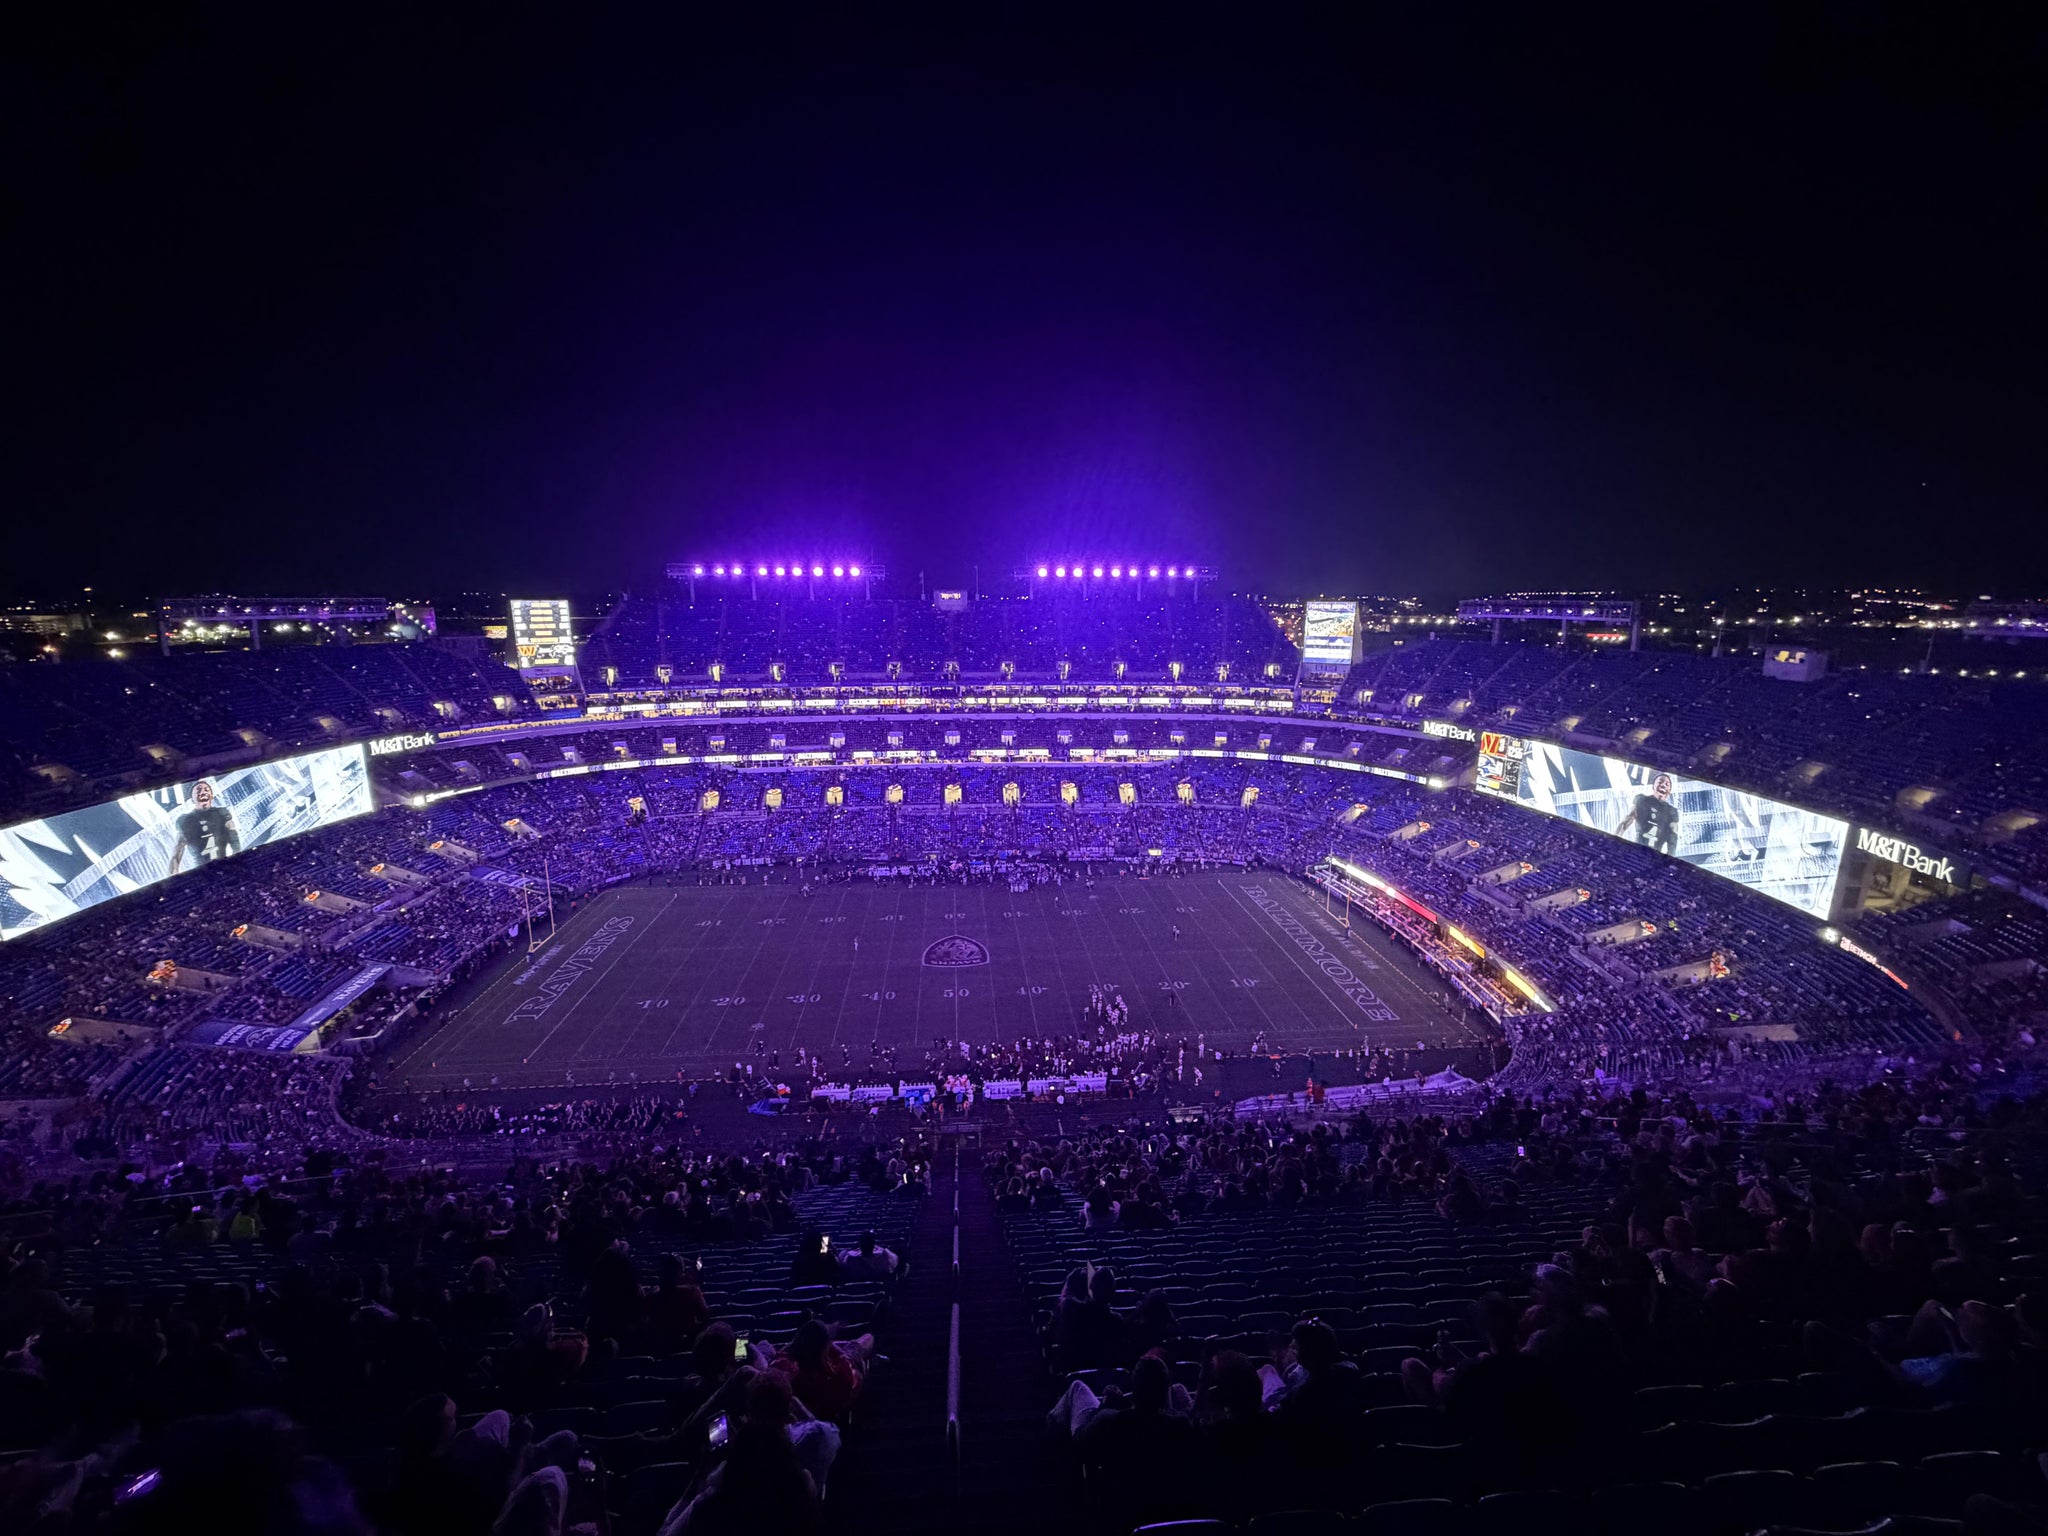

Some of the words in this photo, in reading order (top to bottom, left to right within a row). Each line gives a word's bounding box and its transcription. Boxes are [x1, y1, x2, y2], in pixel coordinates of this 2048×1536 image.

[1423, 720, 1449, 737] M&T
[1449, 726, 1476, 742] Bank
[369, 736, 404, 756] M&T
[404, 732, 435, 749] Bank
[1856, 828, 1906, 863] M&T
[1903, 846, 1954, 883] Bank
[1238, 884, 1401, 1021] BALTIMORE
[502, 916, 635, 1025] RAVENS
[1088, 983, 1113, 993] 30
[1158, 981, 1182, 991] 20
[1230, 978, 1255, 988] 10
[867, 990, 897, 1001] 40
[943, 988, 970, 999] 50
[1016, 986, 1041, 996] 40
[639, 999, 669, 1009] 10
[716, 996, 746, 1007] 20
[792, 993, 822, 1004] 30
